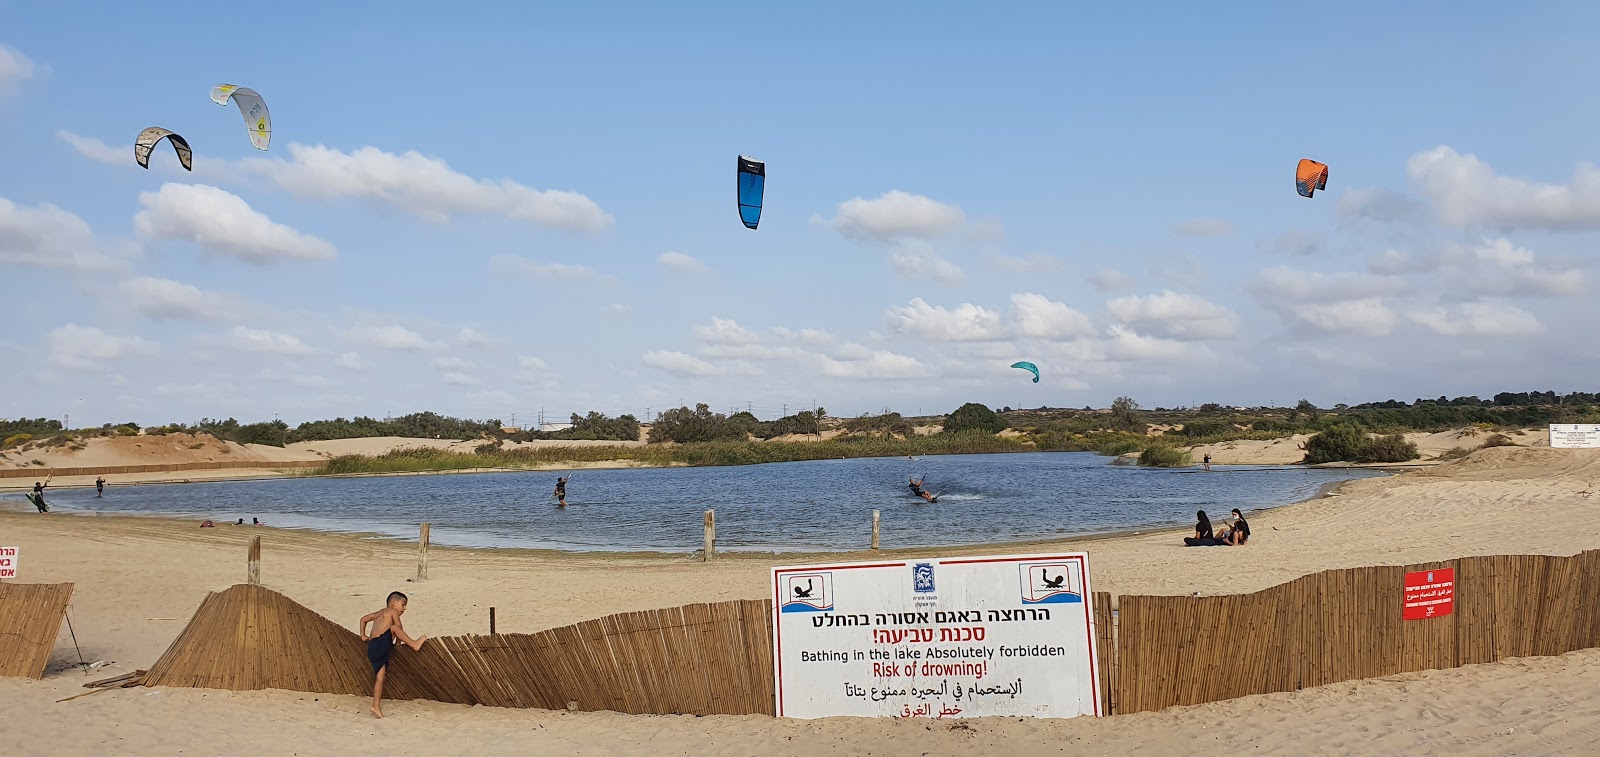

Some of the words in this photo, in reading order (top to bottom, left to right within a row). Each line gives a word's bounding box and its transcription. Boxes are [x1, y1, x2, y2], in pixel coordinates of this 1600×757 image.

[812, 613, 870, 627] בהחלט
[875, 612, 929, 625] אסורה
[935, 610, 982, 624] באגם
[988, 608, 1051, 622] הרחצה
[873, 628, 933, 644] טביעה!
[940, 627, 986, 642] סכנת
[801, 650, 848, 663] Bathing
[853, 649, 865, 661] in
[869, 648, 890, 660] the
[895, 647, 921, 659] lake
[926, 646, 994, 660] Absolutely
[1000, 644, 1065, 657] forbidden
[873, 661, 900, 677] Risk
[904, 660, 917, 677] of
[921, 660, 987, 679] drowning!
[871, 687, 906, 701] ممنوع
[952, 682, 963, 702] في
[900, 703, 931, 718] الغرق
[937, 702, 962, 719] خطر
